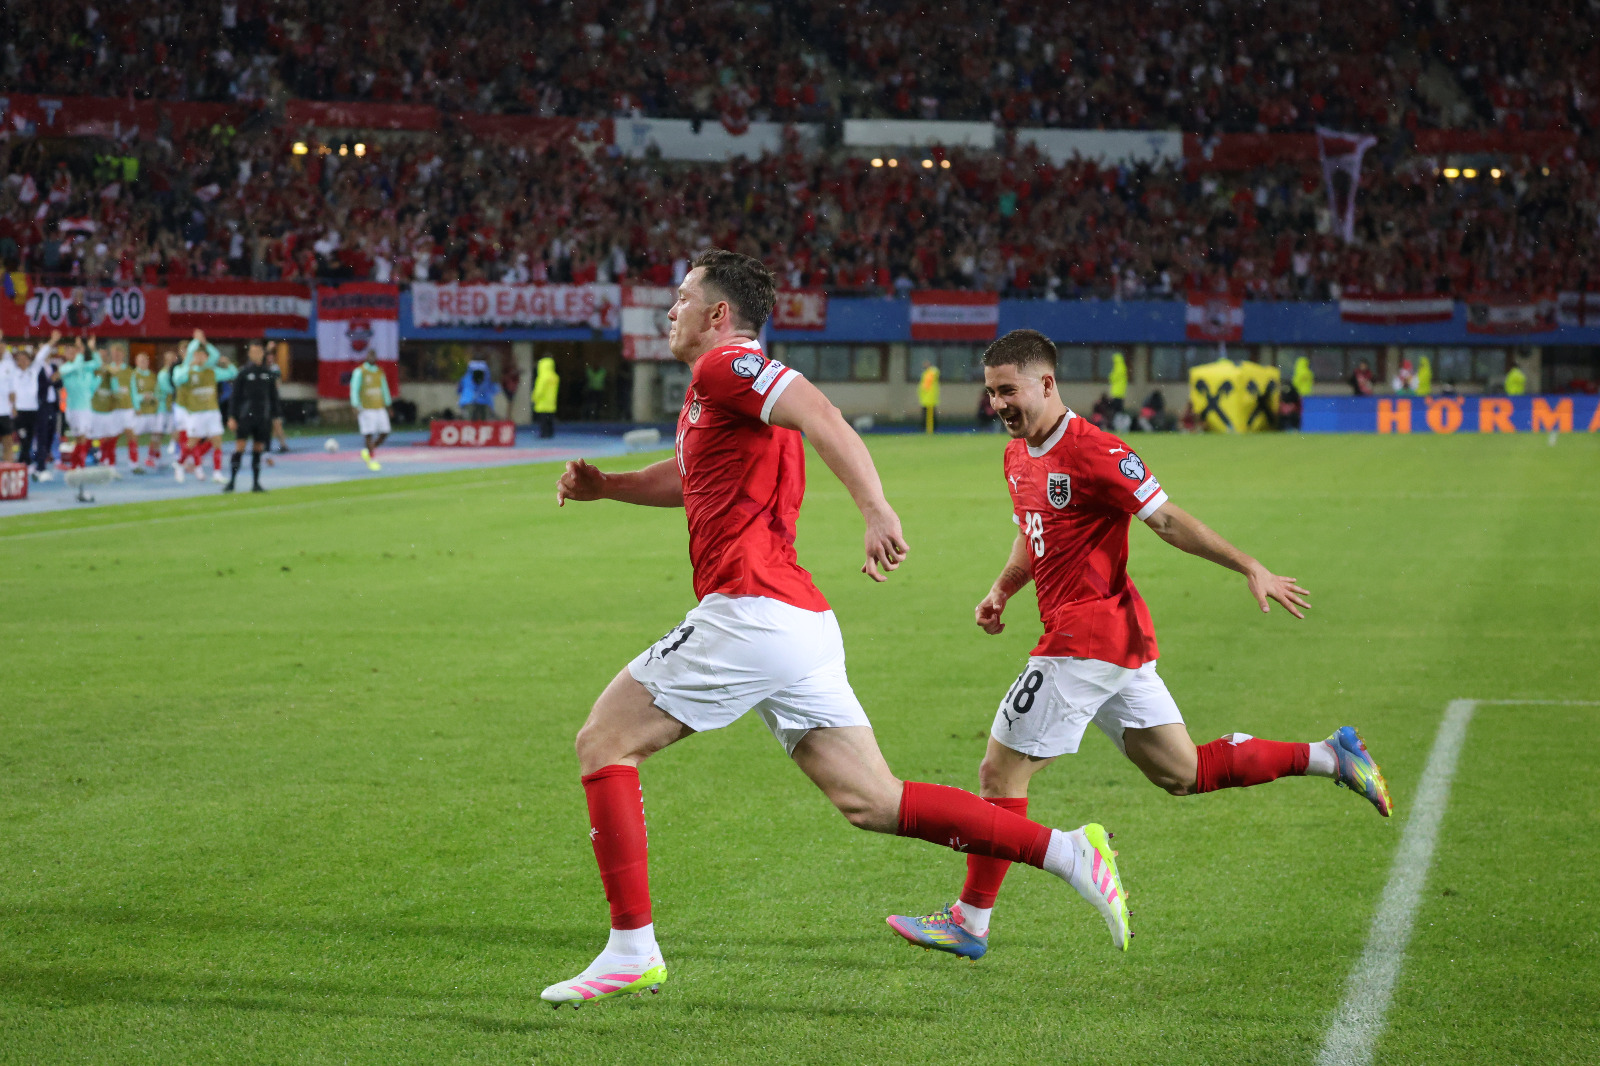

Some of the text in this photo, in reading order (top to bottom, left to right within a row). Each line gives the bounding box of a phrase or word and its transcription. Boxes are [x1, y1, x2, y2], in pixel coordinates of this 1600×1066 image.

[437, 290, 596, 317] RED EAGLES
[440, 424, 495, 445] ORF
[1024, 511, 1045, 558] 18
[1006, 663, 1044, 714] 18
